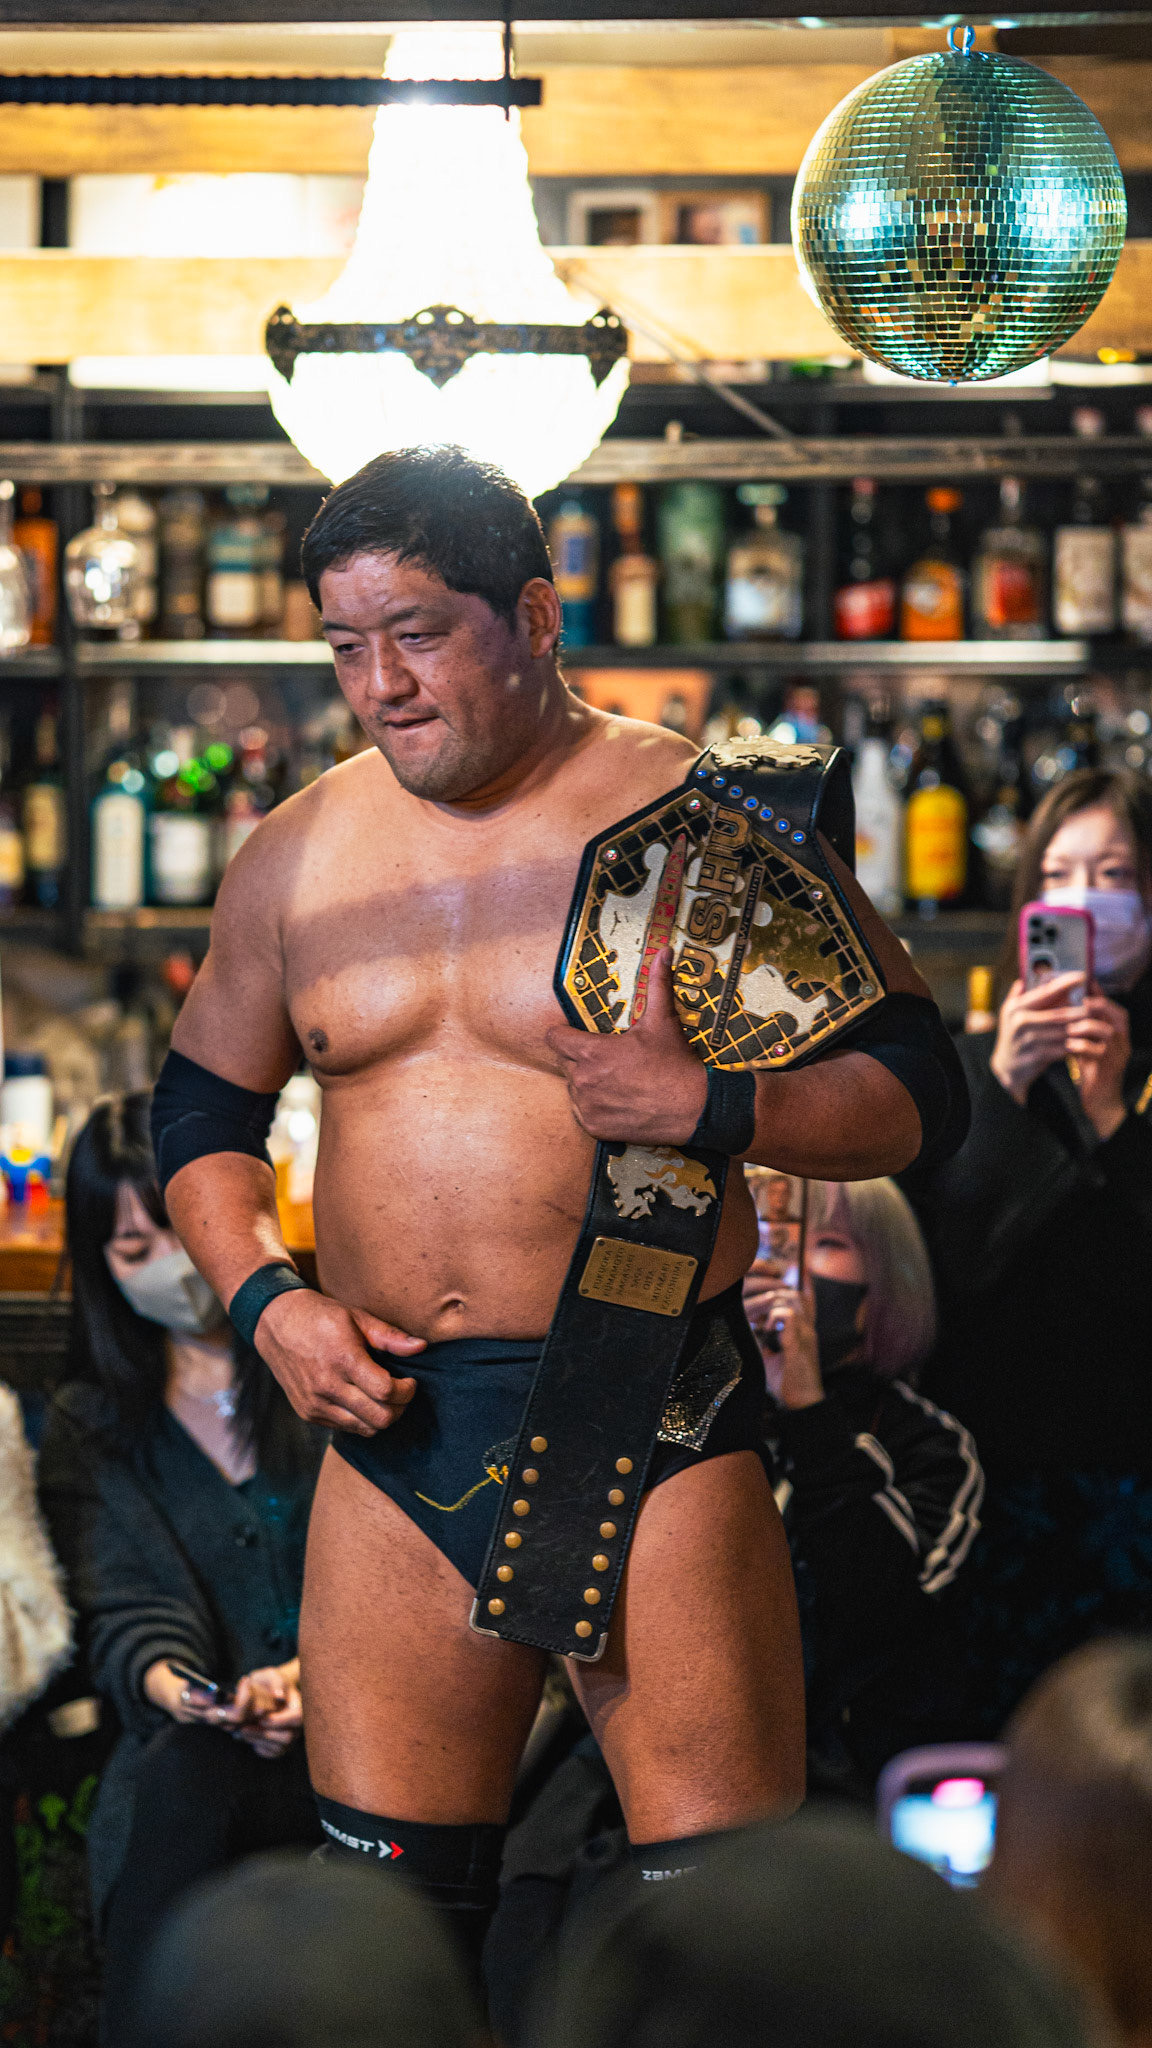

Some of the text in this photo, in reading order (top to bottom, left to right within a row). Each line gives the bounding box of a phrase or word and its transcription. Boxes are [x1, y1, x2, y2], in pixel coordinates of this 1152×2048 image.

[673, 803, 751, 1029] YUSHU
[593, 1250, 613, 1290] FUKUOKA
[603, 1247, 625, 1297] KUMAMOTO
[616, 1254, 636, 1296] NAGASAKI
[644, 1270, 654, 1290] OITA
[651, 1263, 670, 1302] MIYAZAKI
[661, 1261, 684, 1310] KAGOSHIMA
